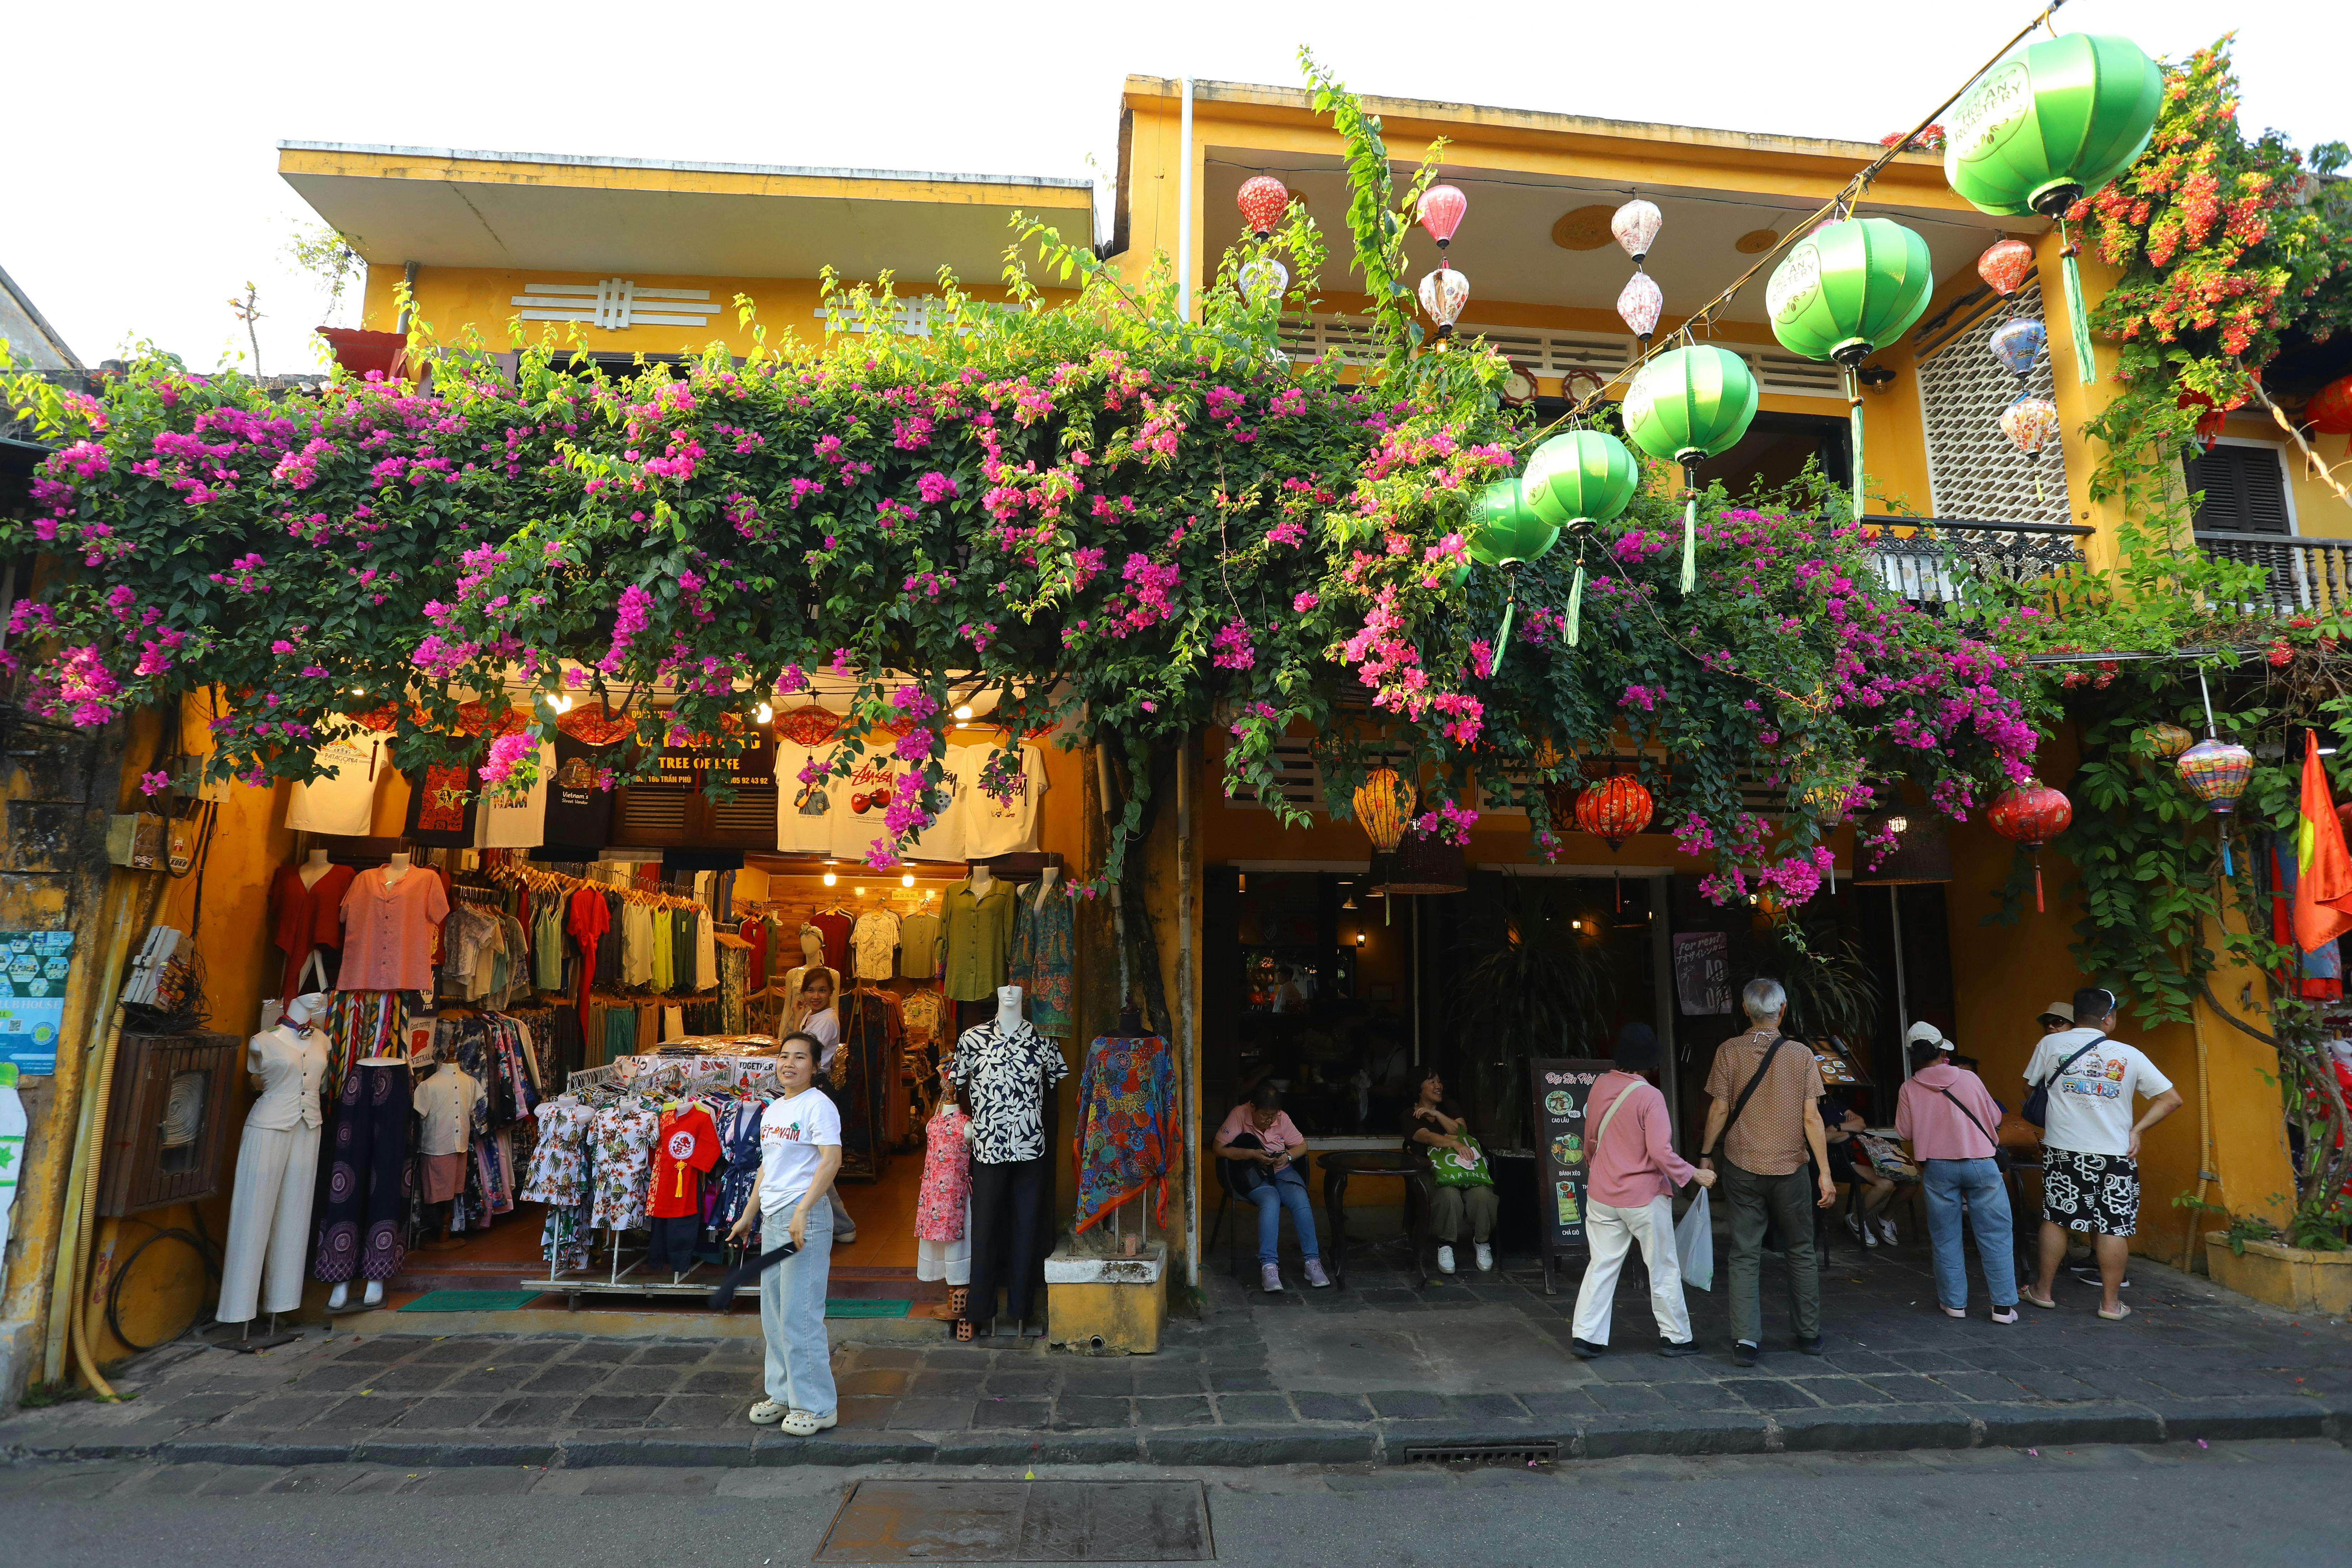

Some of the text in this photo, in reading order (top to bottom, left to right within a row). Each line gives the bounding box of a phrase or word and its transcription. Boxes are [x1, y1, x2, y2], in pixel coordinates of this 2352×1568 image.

[1962, 81, 2007, 124] HOI AN
[1955, 81, 2021, 143] ROASTERY
[1789, 260, 1805, 275] AN
[325, 753, 358, 763] PATAGONIA
[658, 757, 690, 768] TREE
[694, 758, 711, 769] OF
[679, 775, 691, 783] PHÚ
[493, 791, 528, 809] NAM
[1679, 932, 1722, 955] for rent
[21, 1000, 61, 1009] HOUSE
[422, 1003, 433, 1011] you
[410, 1020, 431, 1031] Good morning
[739, 1062, 774, 1071] TOGETHER
[1545, 1072, 1562, 1085] Đặc
[1563, 1072, 1577, 1084] Sản
[777, 1127, 800, 1142] NAM
